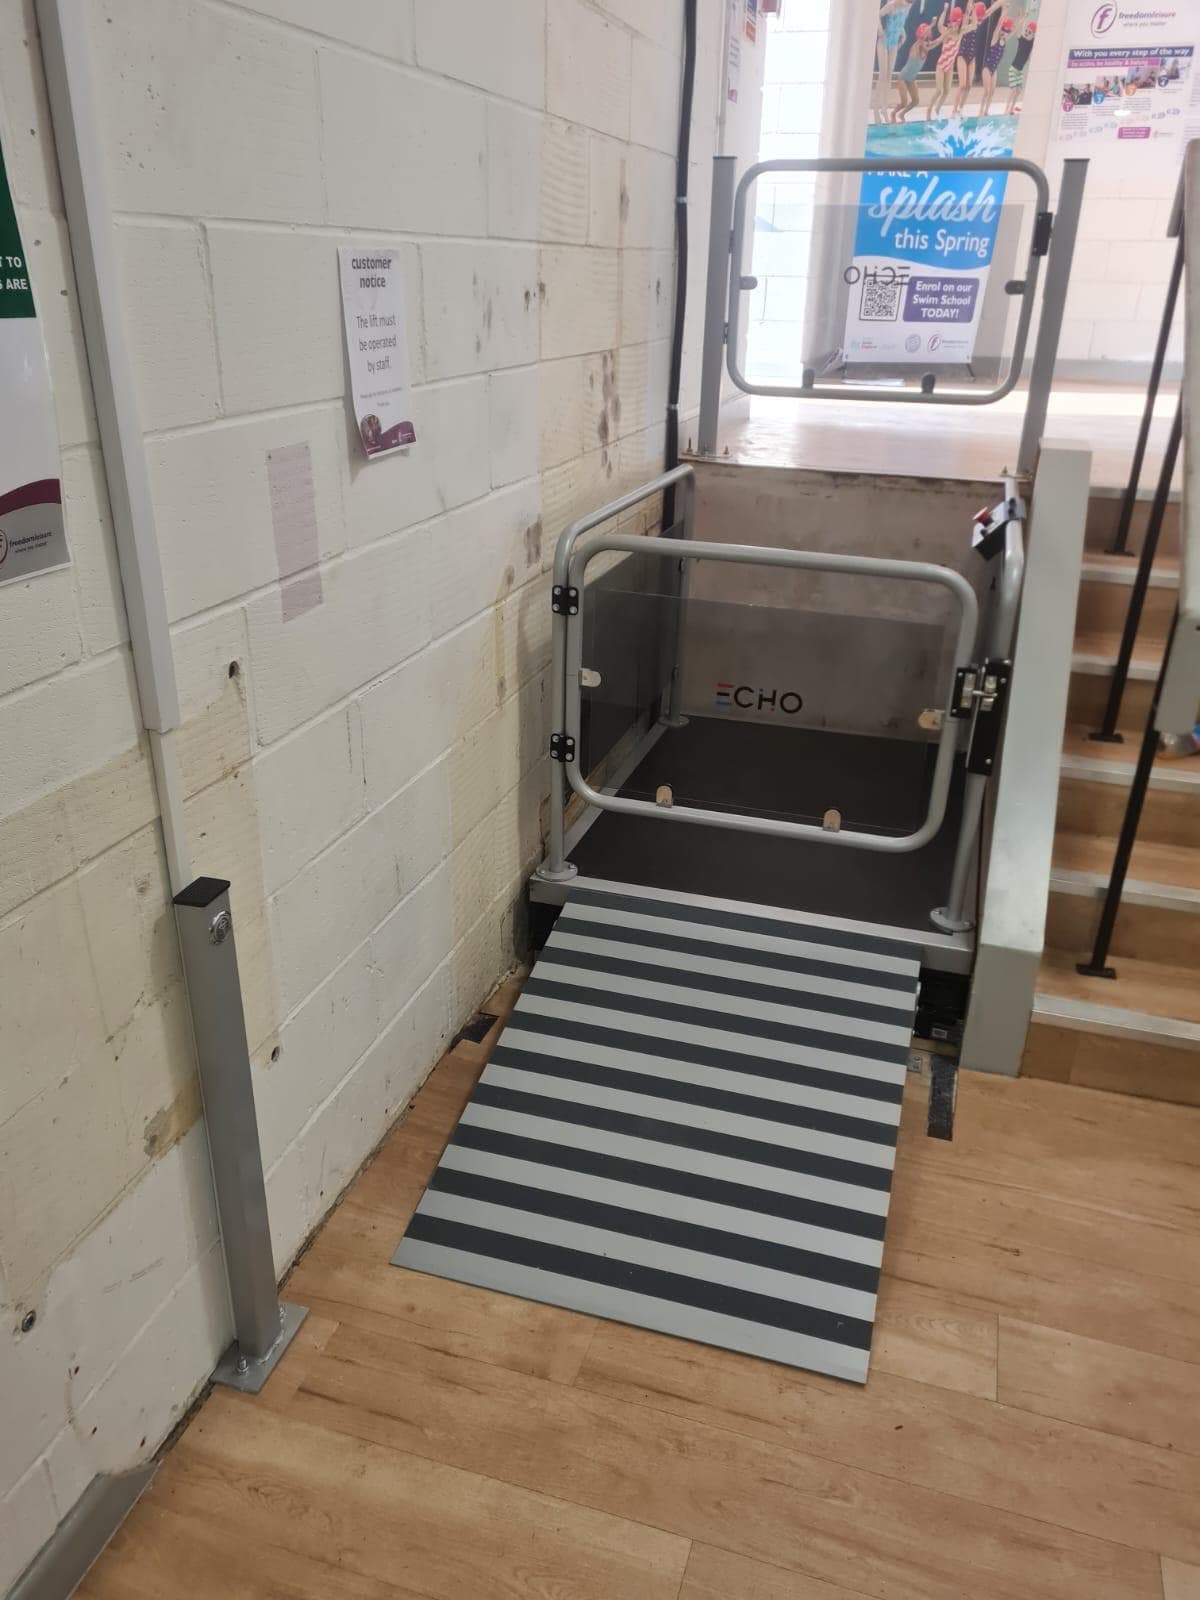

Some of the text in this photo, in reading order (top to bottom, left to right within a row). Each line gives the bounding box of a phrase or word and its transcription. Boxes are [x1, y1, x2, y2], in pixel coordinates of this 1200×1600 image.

[1073, 50, 1093, 58] With
[1094, 51, 1108, 59] you
[1109, 50, 1130, 59] every
[1132, 49, 1149, 58] step
[1174, 49, 1190, 57] way
[867, 176, 997, 237] splash
[894, 228, 990, 258] this Spring
[5, 256, 22, 268] TO
[351, 256, 392, 269] customer
[6, 278, 28, 290] ARE
[359, 274, 386, 288] notice
[915, 281, 973, 292] Enrol on our
[912, 295, 971, 305] Swim School
[921, 308, 960, 318] TODAY!
[356, 314, 396, 328] The lift must
[359, 334, 397, 351] be operated
[367, 359, 375, 375] by
[716, 682, 802, 714] ECHO
